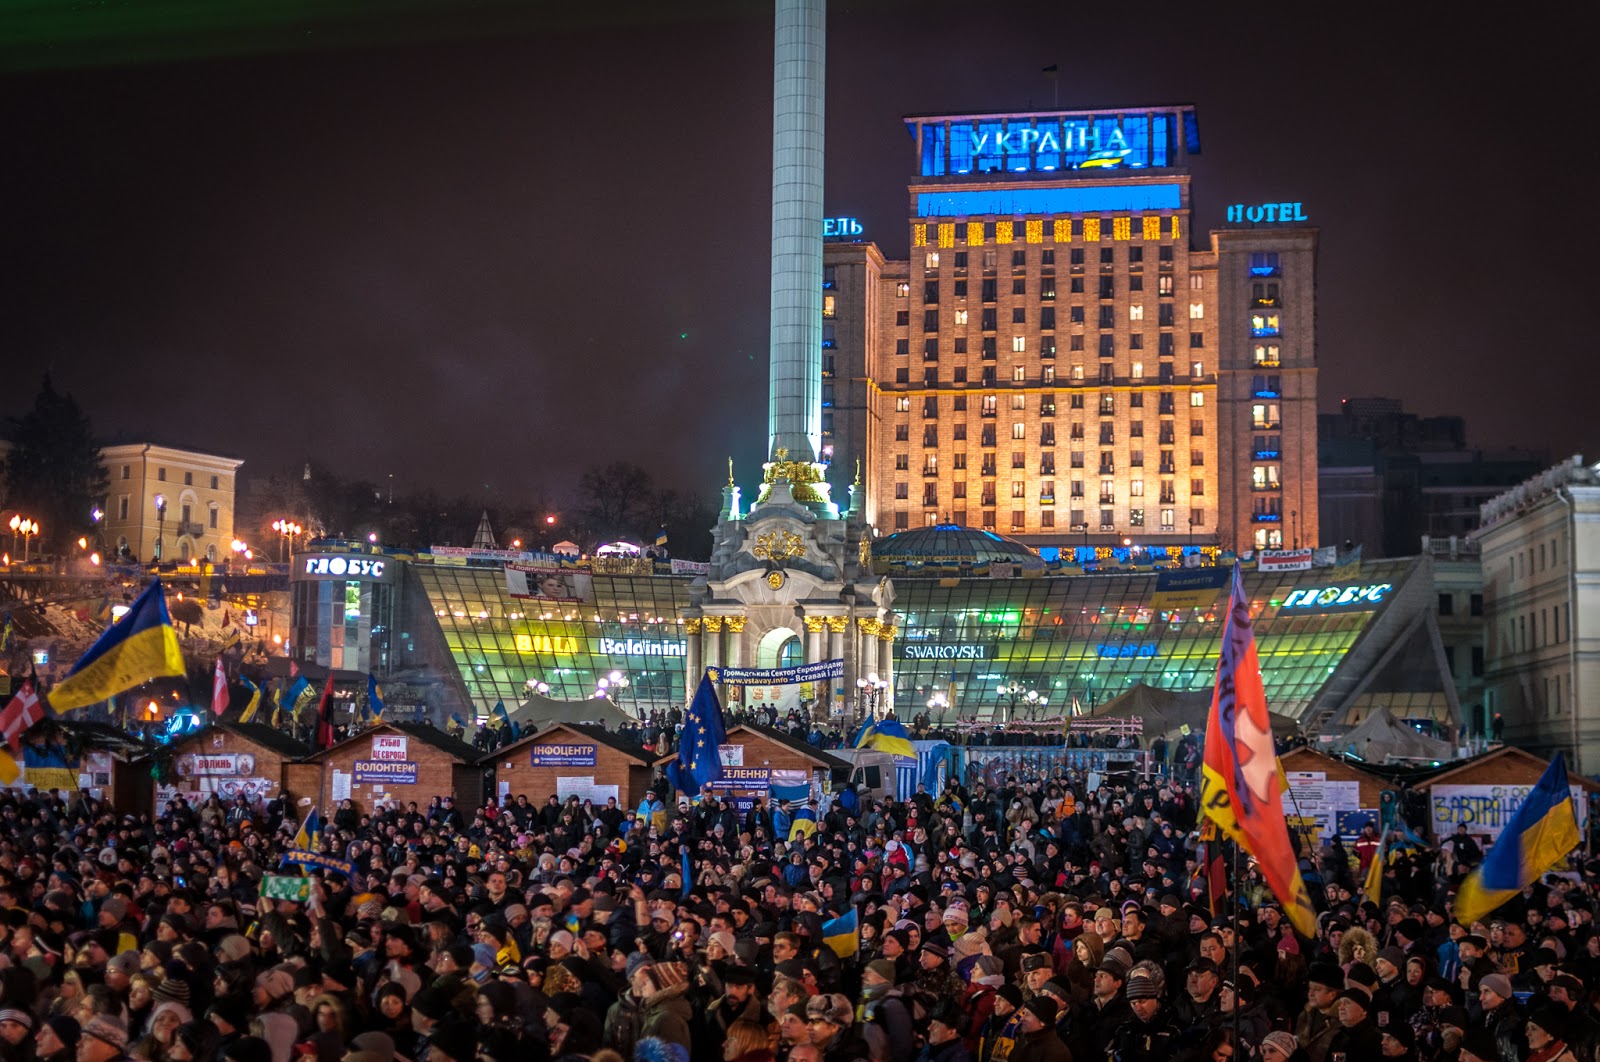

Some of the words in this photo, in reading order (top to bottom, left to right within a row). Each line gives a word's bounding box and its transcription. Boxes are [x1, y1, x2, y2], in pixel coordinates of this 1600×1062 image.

[969, 121, 1129, 155] УКРАЇНА
[1226, 202, 1308, 223] HOTEL
[305, 556, 385, 577] ГЛОБУС
[1282, 583, 1391, 608] ГЛОБУС
[515, 634, 578, 654] BILLA
[600, 637, 687, 656] Baldinini
[905, 645, 984, 658] SWAROVSKI
[723, 669, 770, 678] Громадський
[770, 669, 795, 677] Сектор
[795, 671, 826, 682] Вставай
[380, 738, 400, 748] ДУБНО
[381, 750, 405, 759] ЄВРОПА
[534, 746, 594, 757] ІНФОЦЕНТР
[198, 759, 232, 769] ВОЛИНЬ
[355, 762, 416, 773] ВОЛОНТЕРИ
[288, 851, 351, 873] УКРАЇНА
